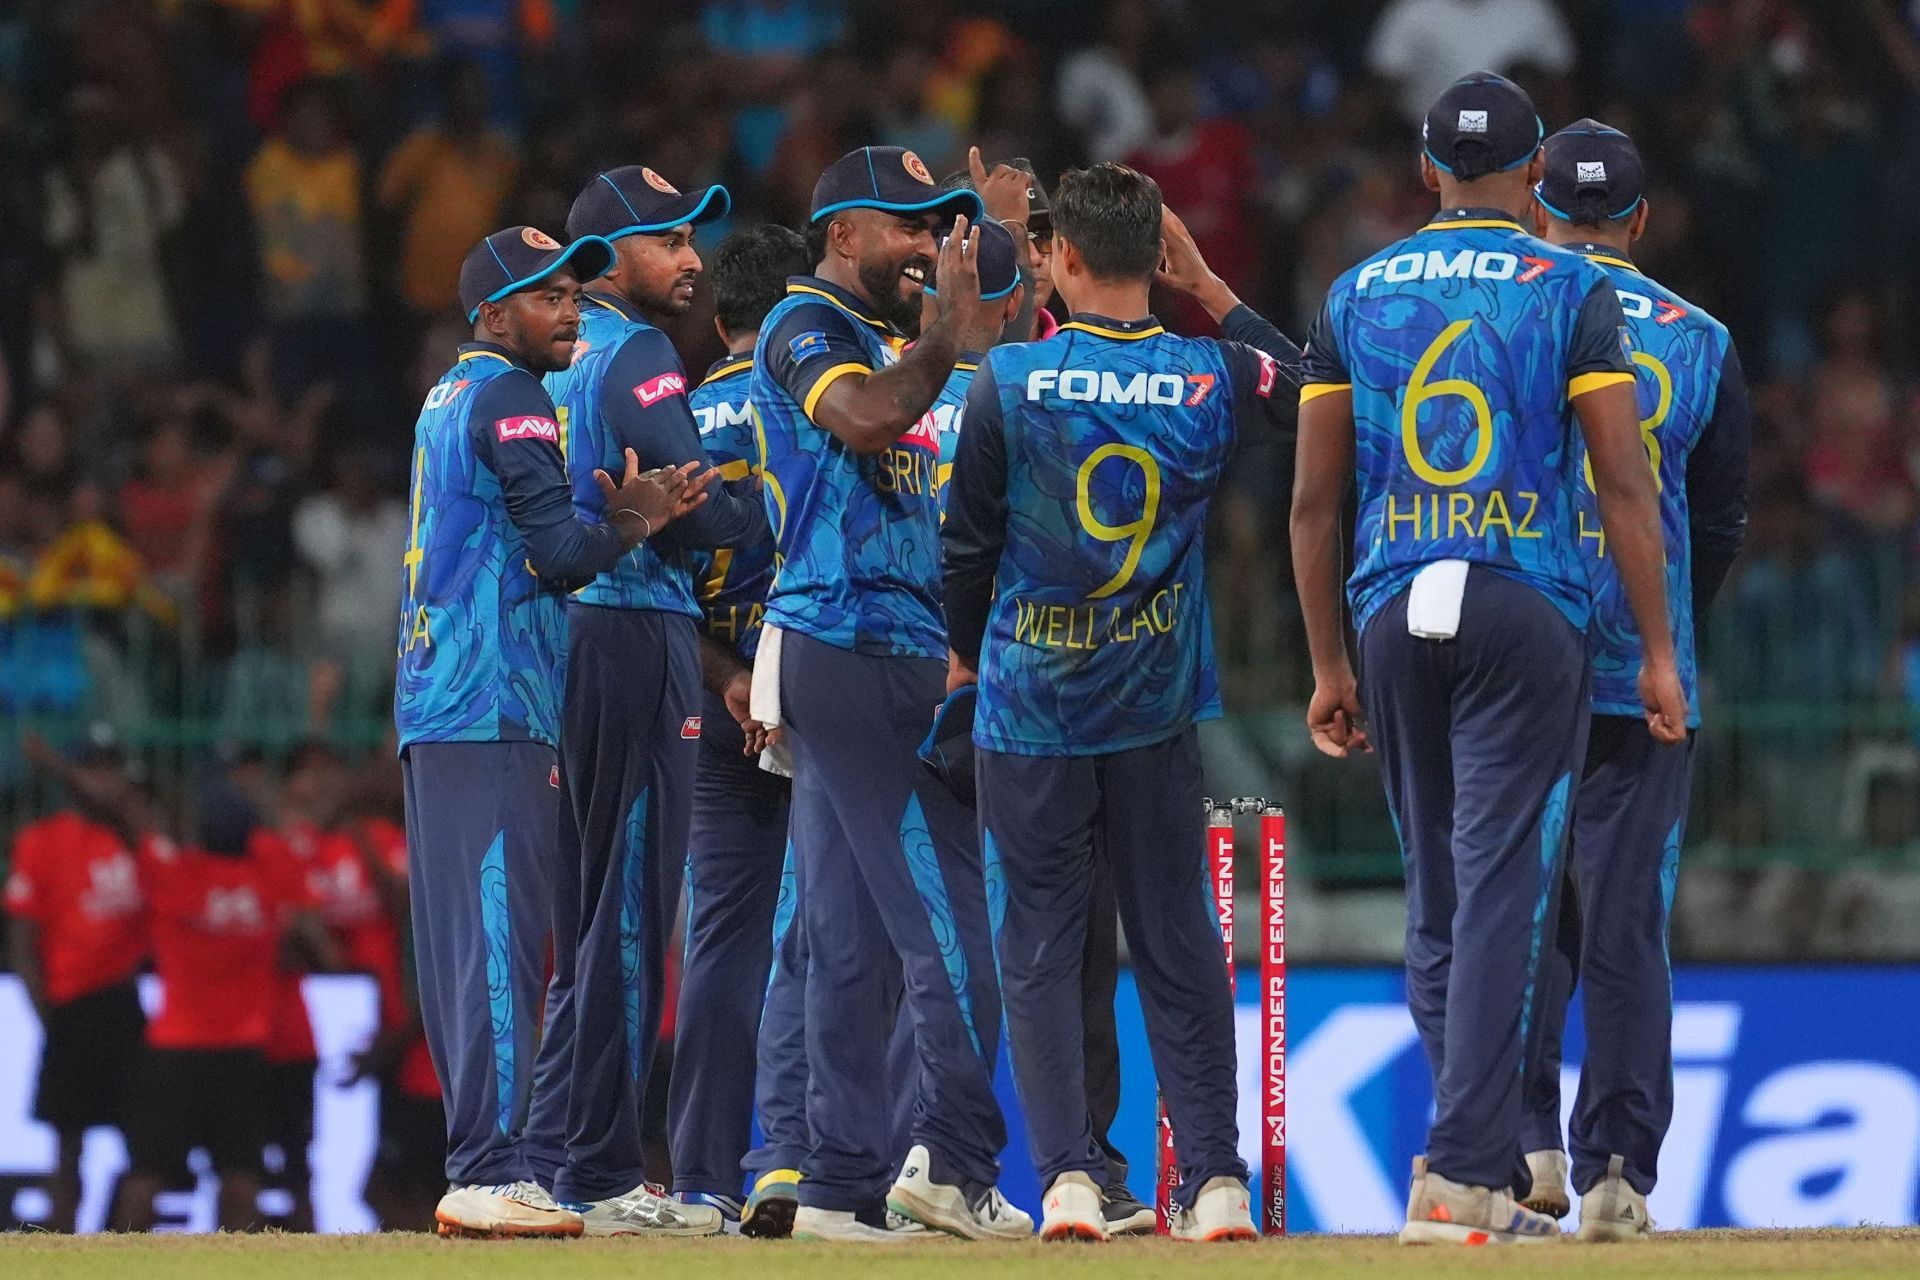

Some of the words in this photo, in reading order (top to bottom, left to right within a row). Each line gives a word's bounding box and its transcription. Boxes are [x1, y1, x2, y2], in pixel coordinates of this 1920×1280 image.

[500, 419, 558, 441] LAVA
[638, 376, 686, 401] LAV
[1401, 320, 1493, 486] 6
[877, 447, 922, 495] SRI
[1076, 443, 1160, 599] 9
[1376, 490, 1543, 542] HIRAZ
[1269, 838, 1285, 964] CEMENT
[1269, 976, 1285, 1107] WONDER
